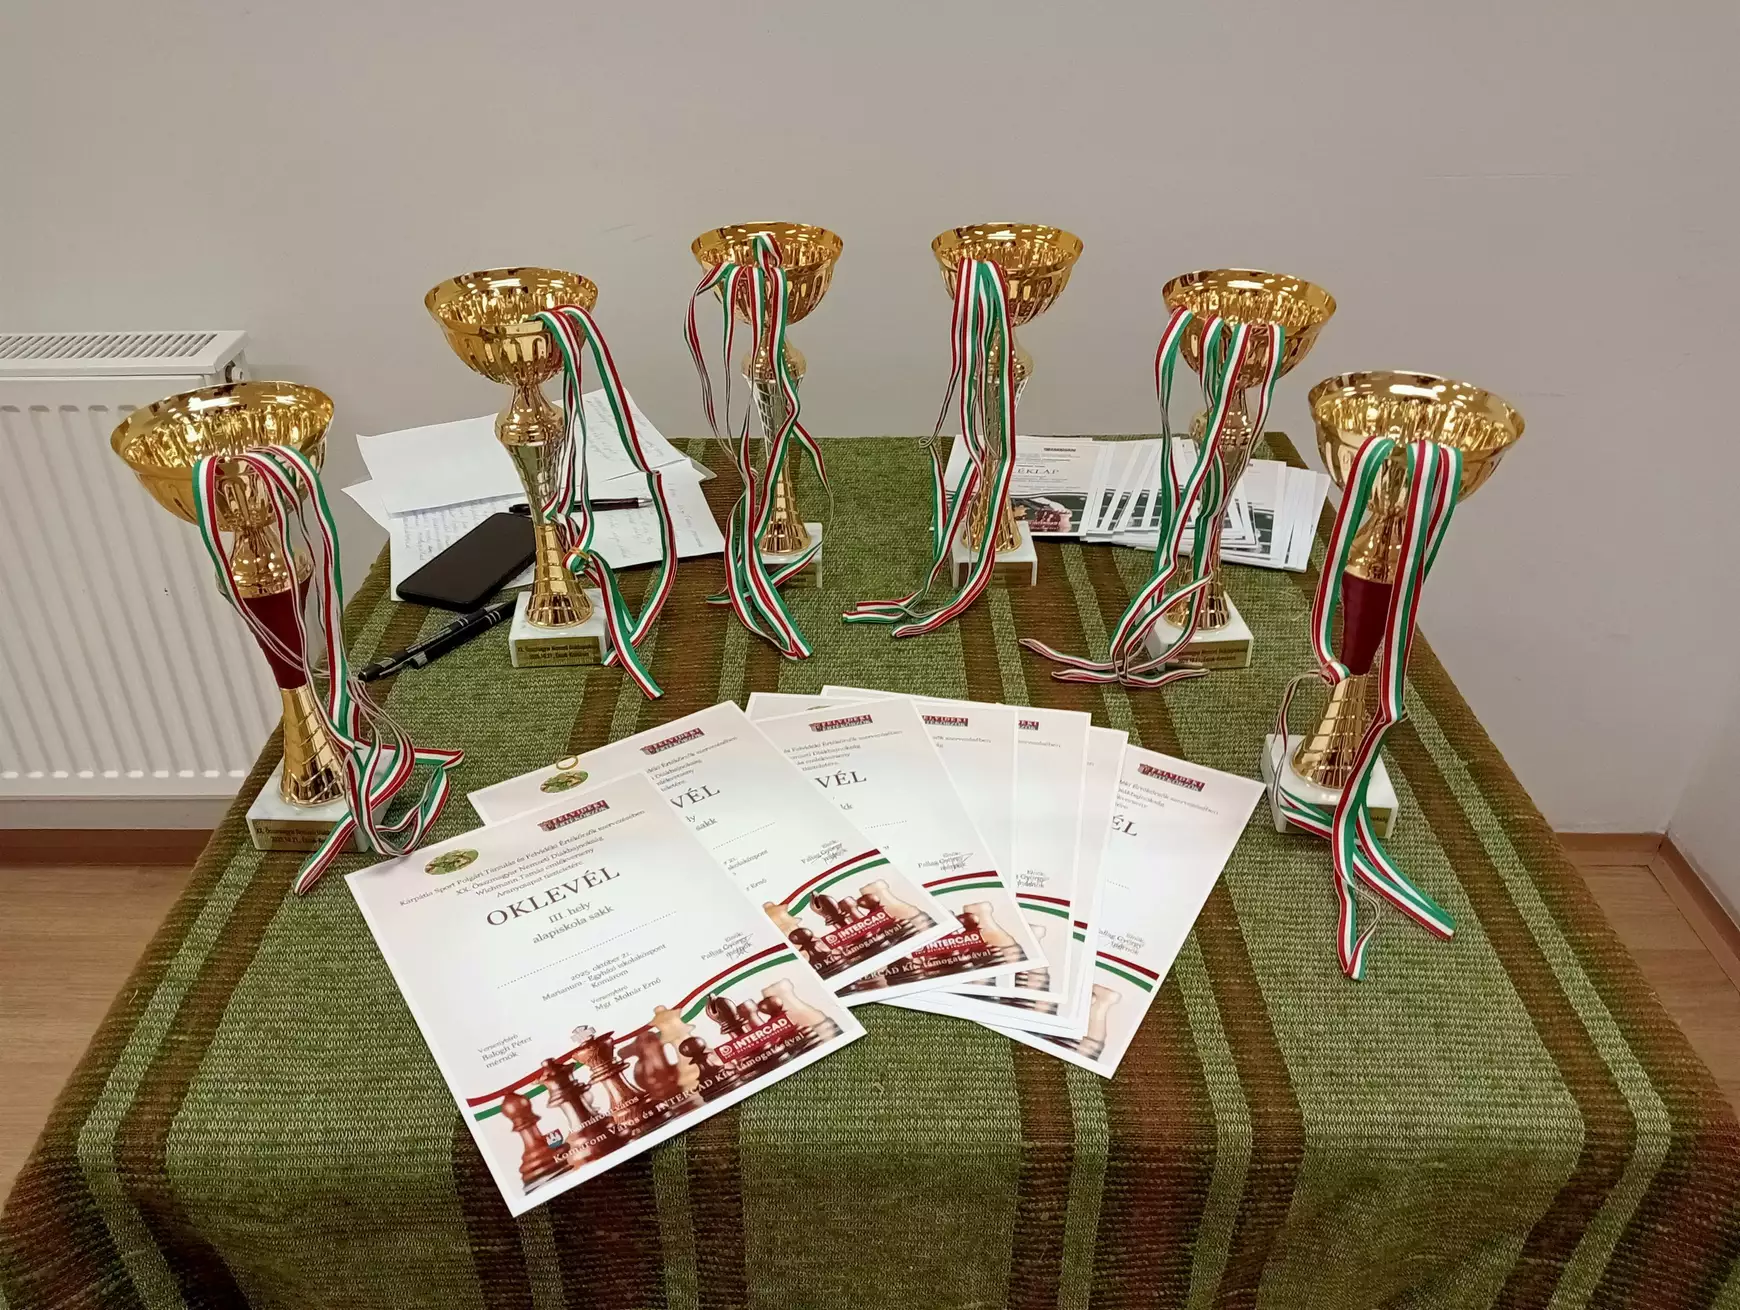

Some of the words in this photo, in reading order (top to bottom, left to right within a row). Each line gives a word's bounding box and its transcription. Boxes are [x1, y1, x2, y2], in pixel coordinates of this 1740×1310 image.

[434, 882, 456, 895] Sport
[486, 867, 620, 926] OKLEVÉL
[532, 917, 587, 944] alapiskola
[589, 904, 614, 921] sakk
[548, 912, 567, 924] III.
[568, 901, 591, 916] hely
[837, 912, 886, 938] INTERCAD
[732, 1018, 788, 1050] INTERCAD
